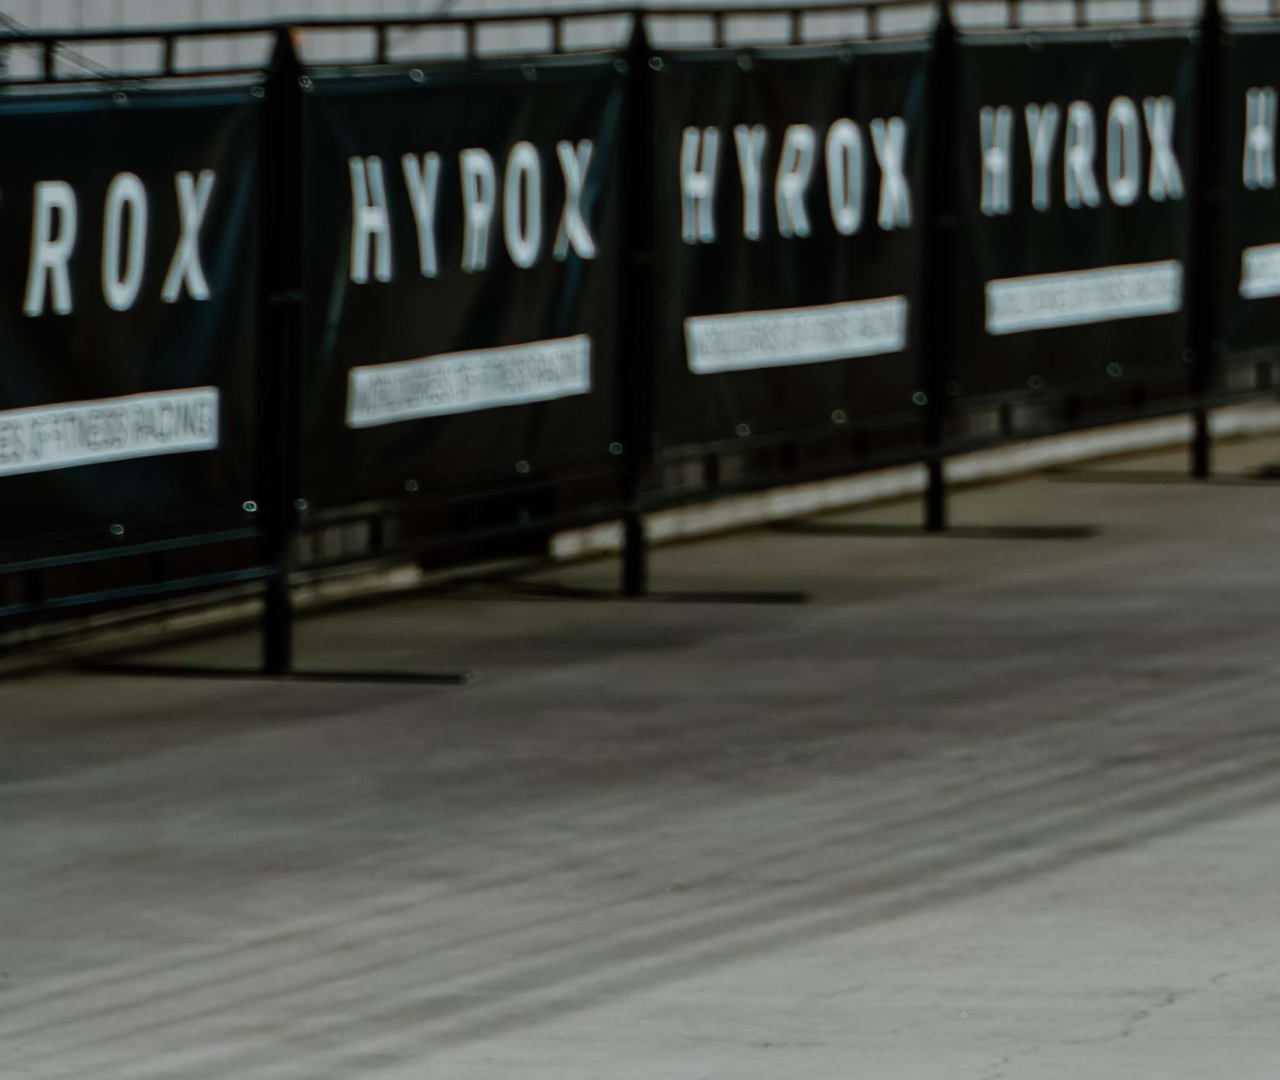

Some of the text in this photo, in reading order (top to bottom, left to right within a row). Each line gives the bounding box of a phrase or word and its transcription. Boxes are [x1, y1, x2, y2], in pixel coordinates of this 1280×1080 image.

[348, 140, 597, 285] HYROX
[679, 116, 912, 243] HYROX
[979, 96, 1184, 215] HYROX
[22, 170, 216, 317] ROX
